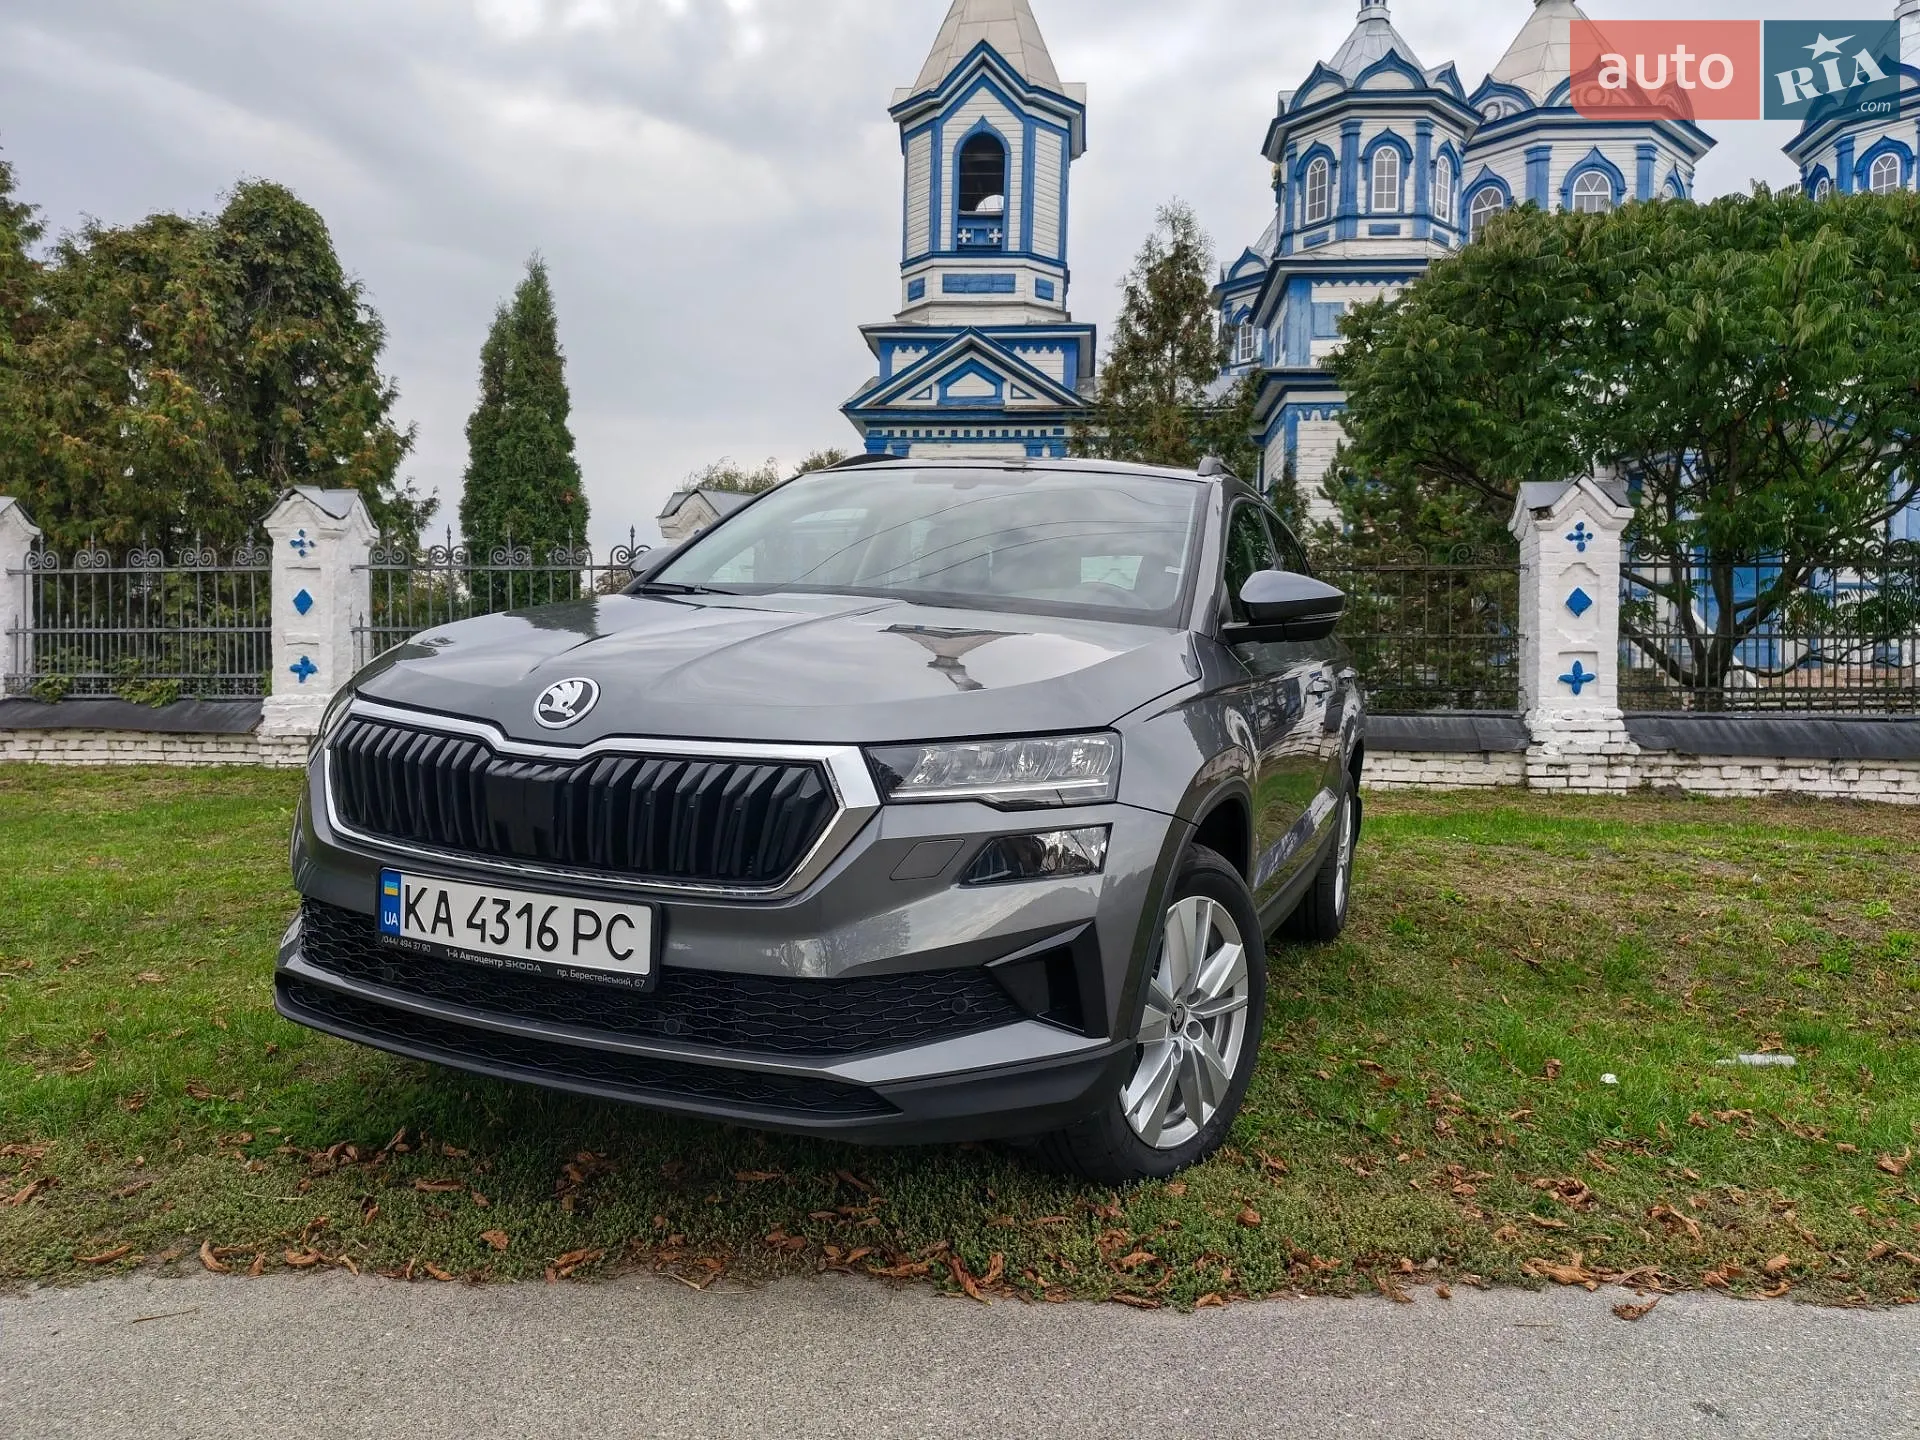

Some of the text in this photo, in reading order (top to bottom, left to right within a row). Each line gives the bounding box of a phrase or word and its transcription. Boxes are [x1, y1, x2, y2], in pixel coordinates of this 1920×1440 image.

[384, 911, 399, 926] UA
[404, 884, 635, 961] KA 4316 PC
[459, 950, 503, 968] Автоцентр
